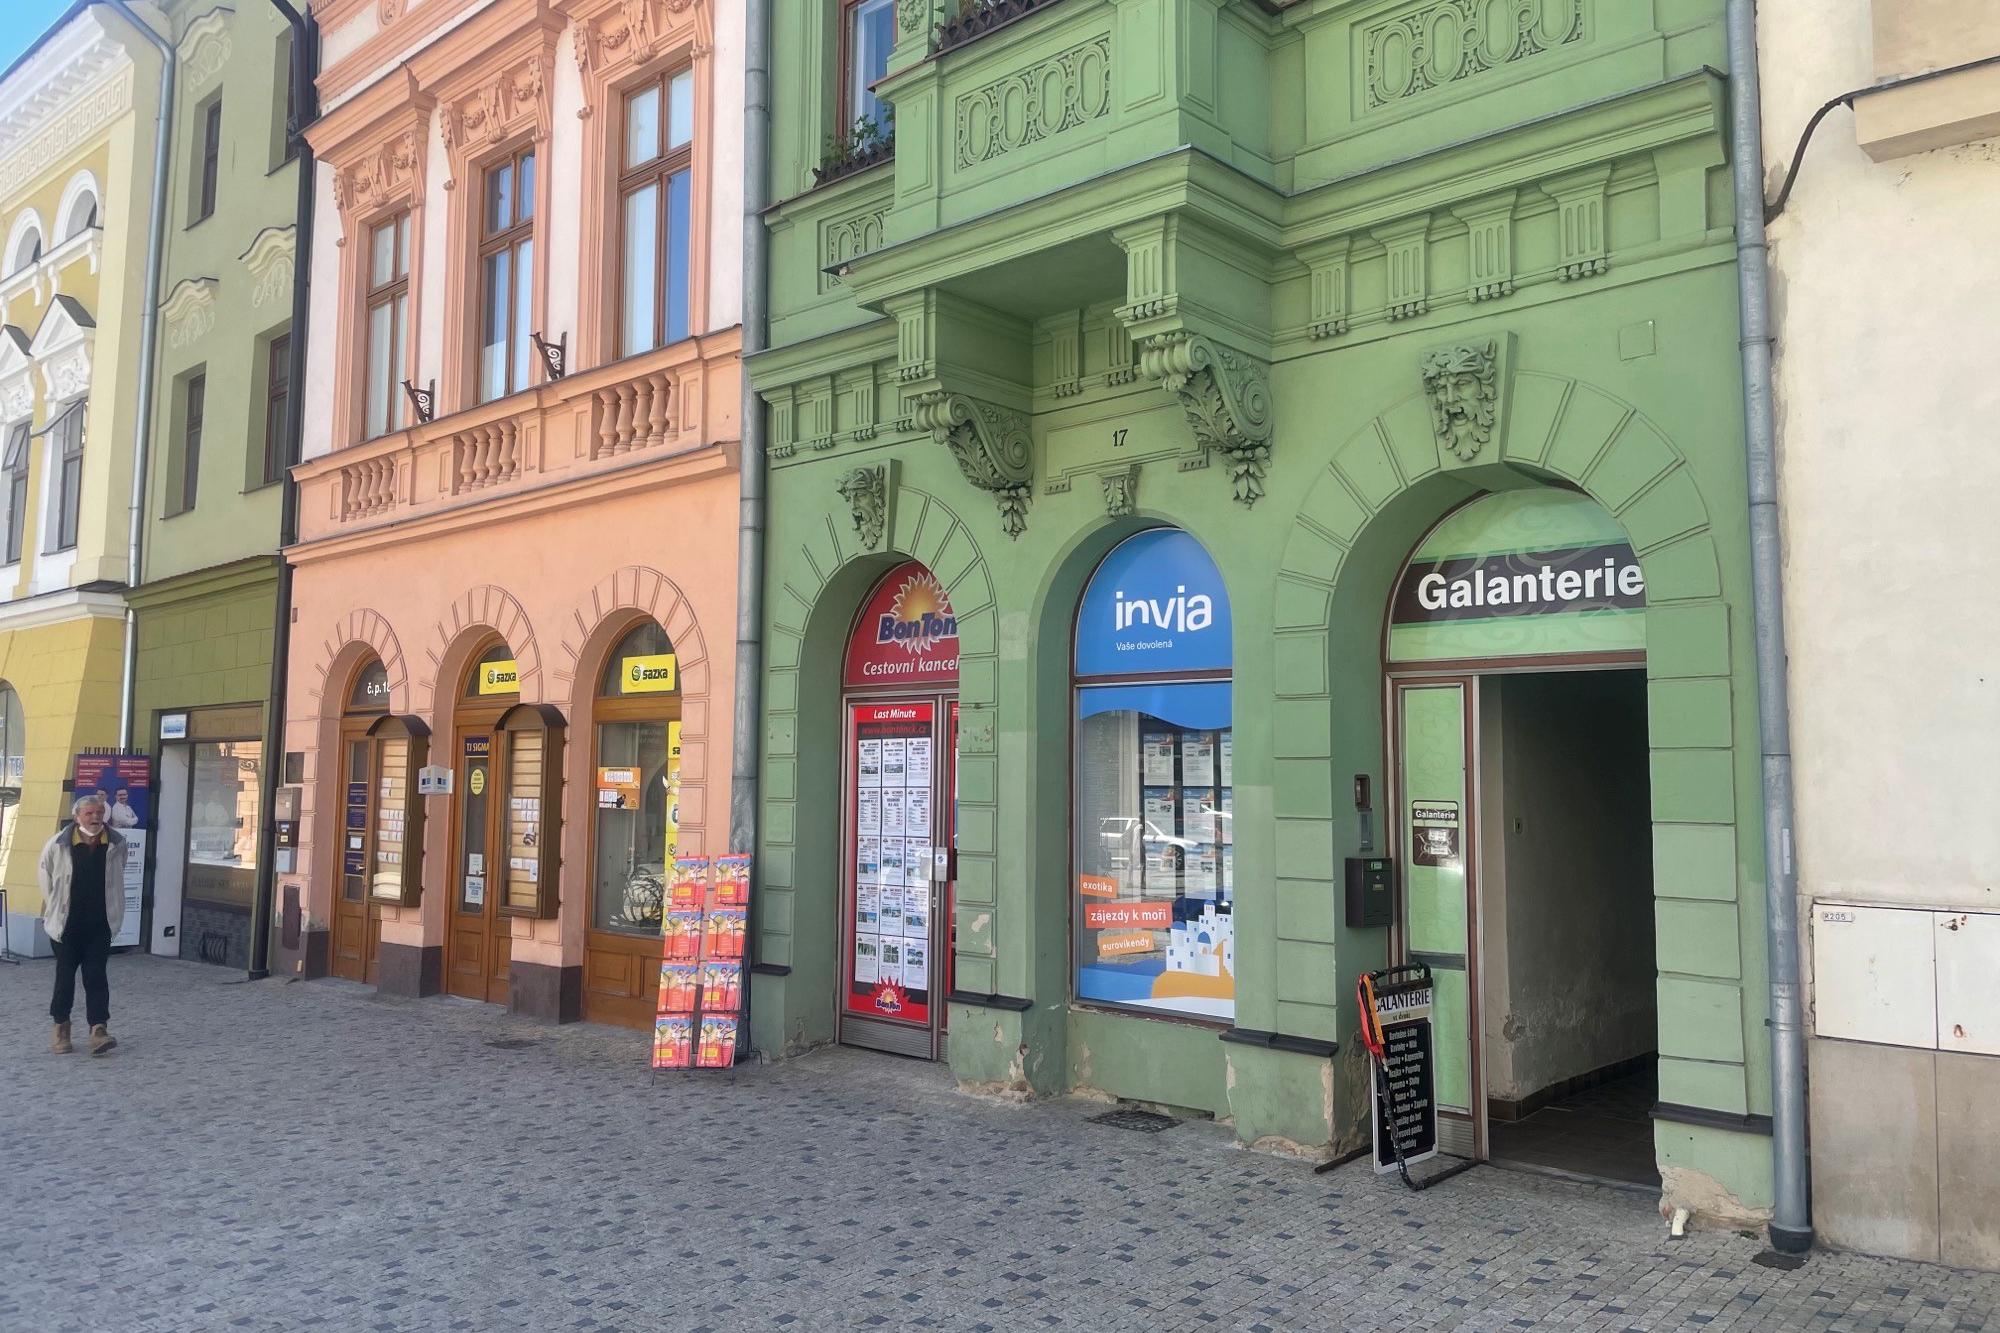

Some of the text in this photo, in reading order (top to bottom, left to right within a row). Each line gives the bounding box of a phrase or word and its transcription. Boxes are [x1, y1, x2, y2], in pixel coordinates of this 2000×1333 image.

[1112, 428, 1129, 447] 17
[1417, 557, 1645, 610] Galanterie
[1115, 584, 1213, 633] invia
[1115, 638, 1174, 652] Vaše dovolená
[862, 657, 916, 676] Cestovní
[873, 708, 917, 720] Last Minute
[1415, 810, 1456, 819] Galanterie
[1082, 881, 1113, 893] exotika
[1090, 909, 1167, 923] zájezdy k moři
